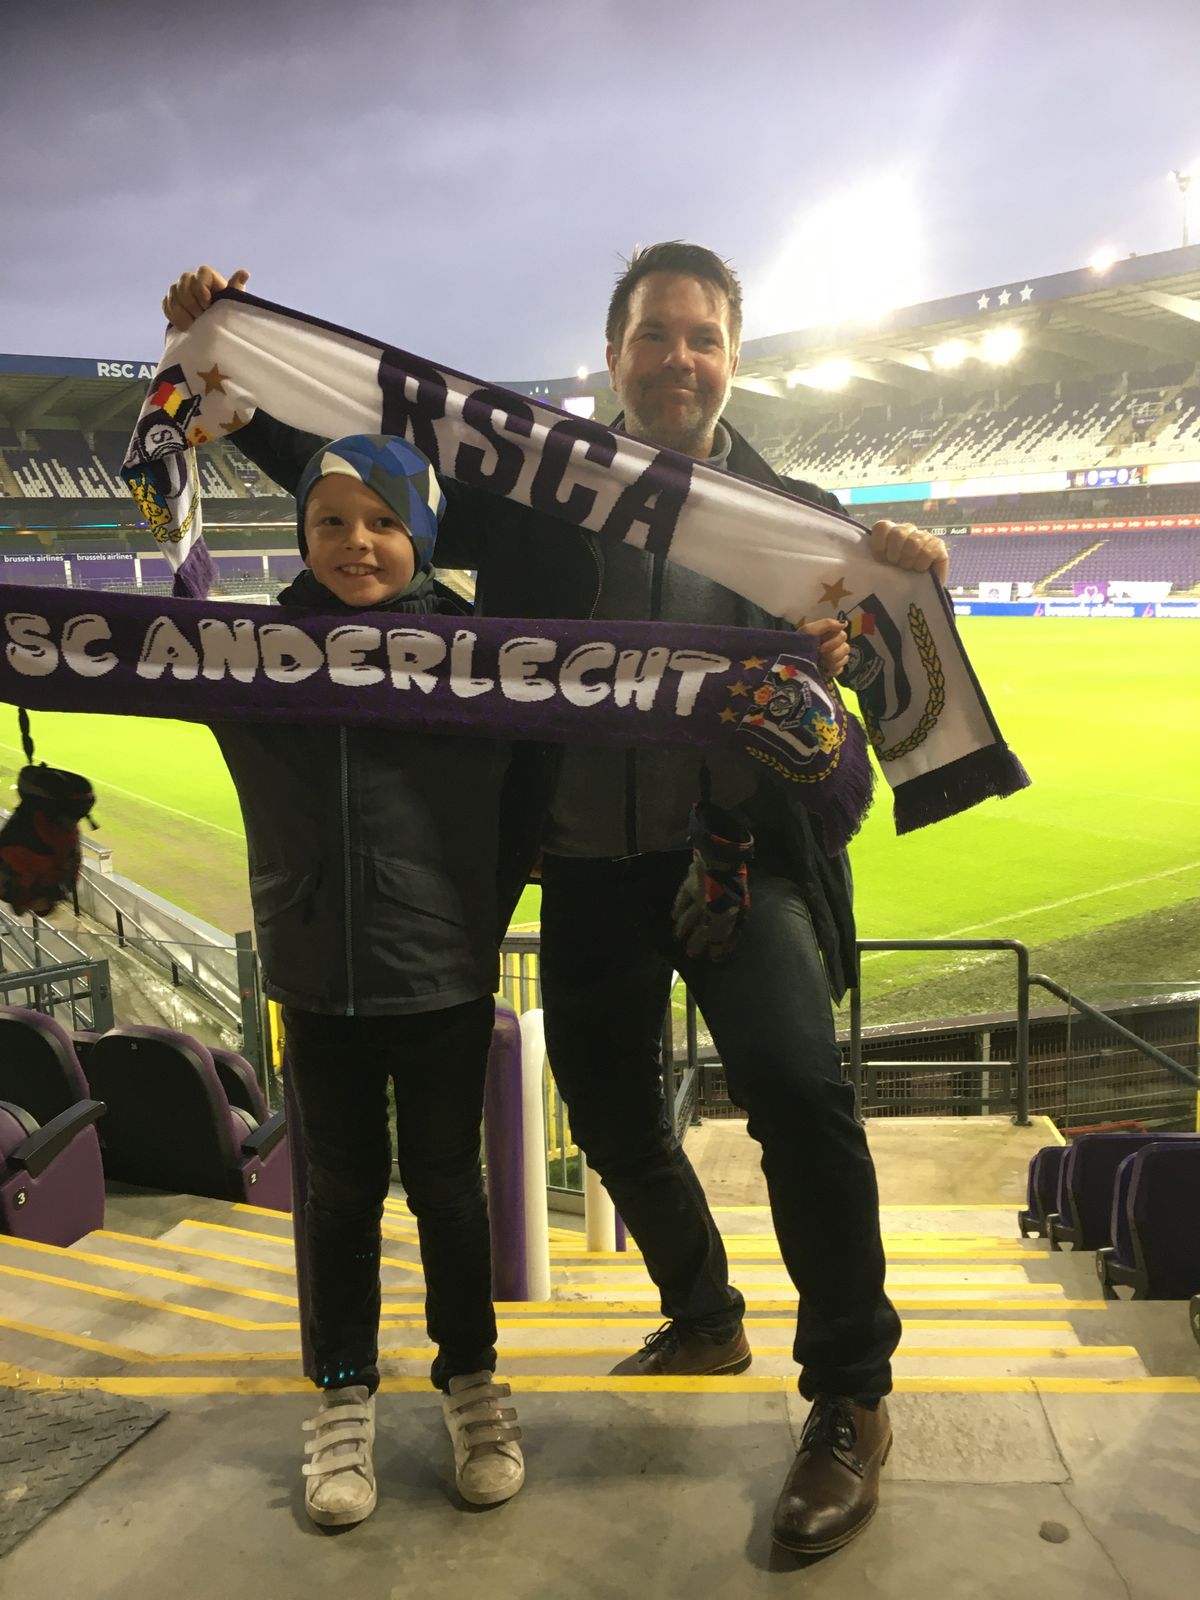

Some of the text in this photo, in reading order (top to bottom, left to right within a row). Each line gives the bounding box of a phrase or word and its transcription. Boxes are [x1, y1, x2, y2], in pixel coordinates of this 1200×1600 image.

[97, 362, 135, 378] RSC
[378, 350, 692, 554] RSCA
[950, 527, 968, 535] Audi
[4, 554, 64, 563] brussels airlines
[76, 553, 106, 561] brussels
[4, 612, 732, 717] SC ANDERLECHT
[251, 1173, 257, 1184] 2
[17, 1192, 26, 1205] 3
